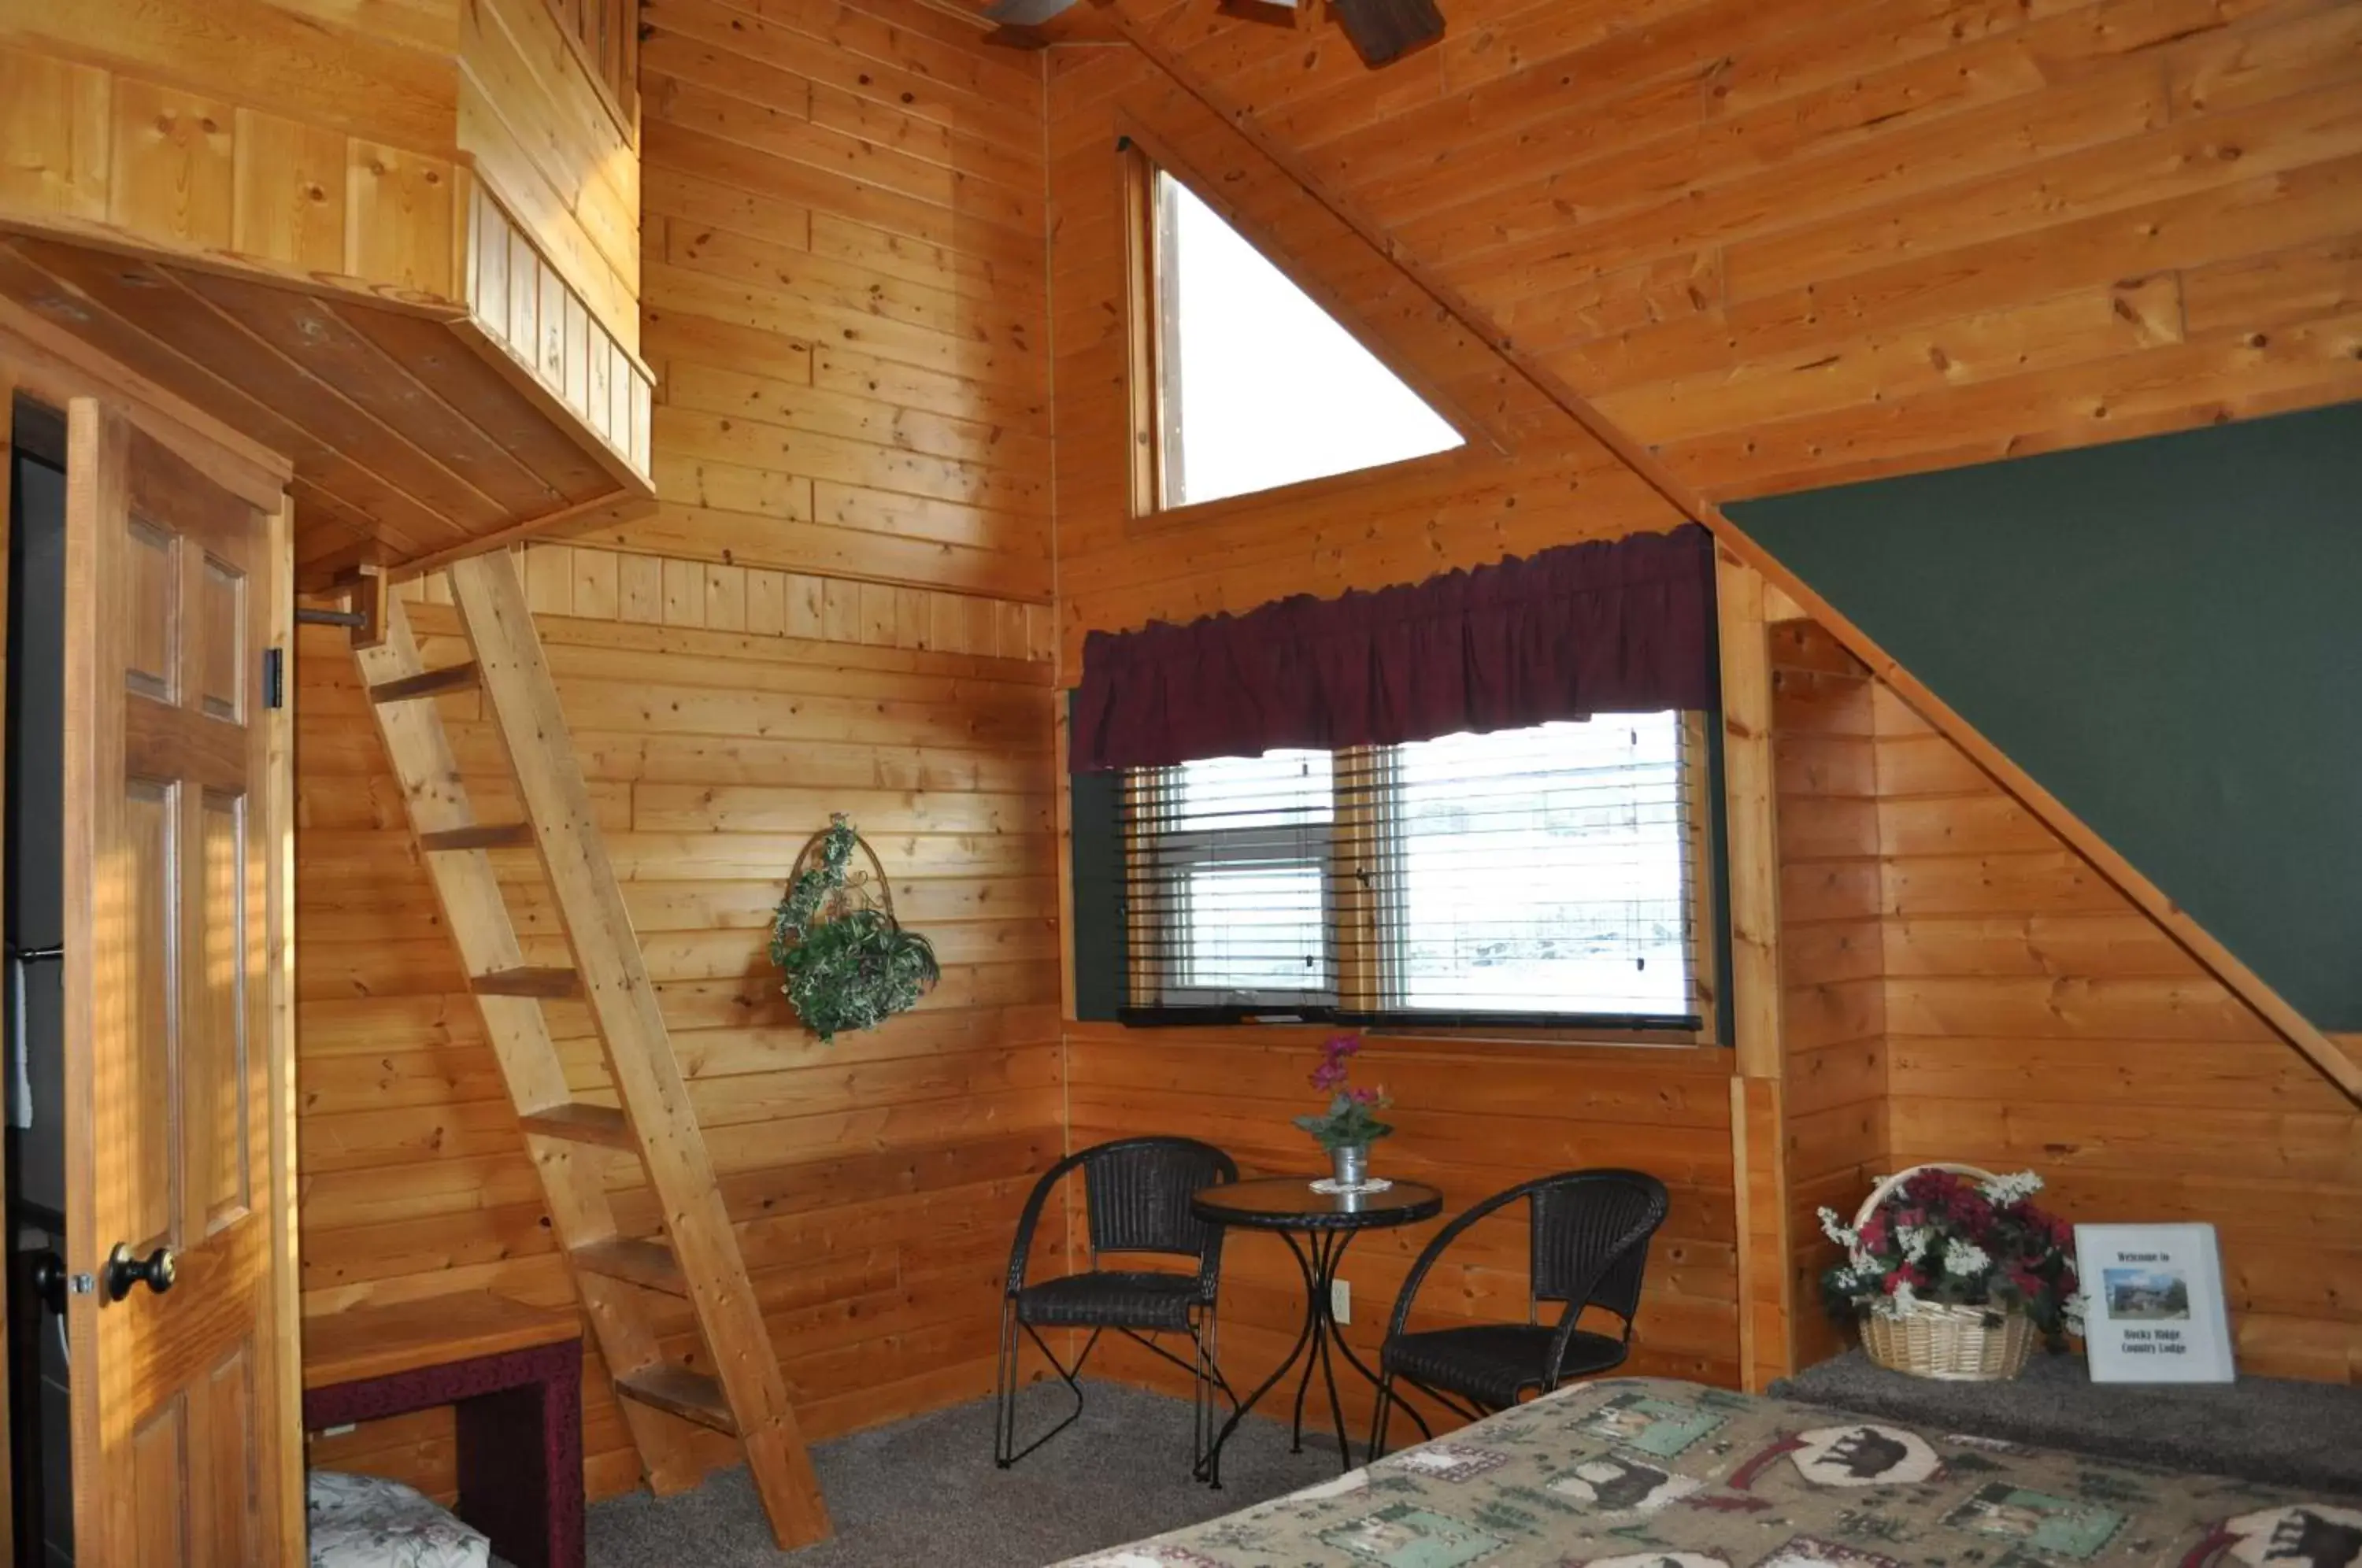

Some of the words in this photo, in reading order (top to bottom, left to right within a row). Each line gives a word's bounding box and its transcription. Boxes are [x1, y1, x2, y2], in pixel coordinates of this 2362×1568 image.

[2117, 1252, 2157, 1262] Welcome
[2123, 1329, 2151, 1341] Rocky
[2154, 1329, 2180, 1341] Ridge
[2122, 1342, 2156, 1354] Country
[2159, 1342, 2186, 1354] Lodge
